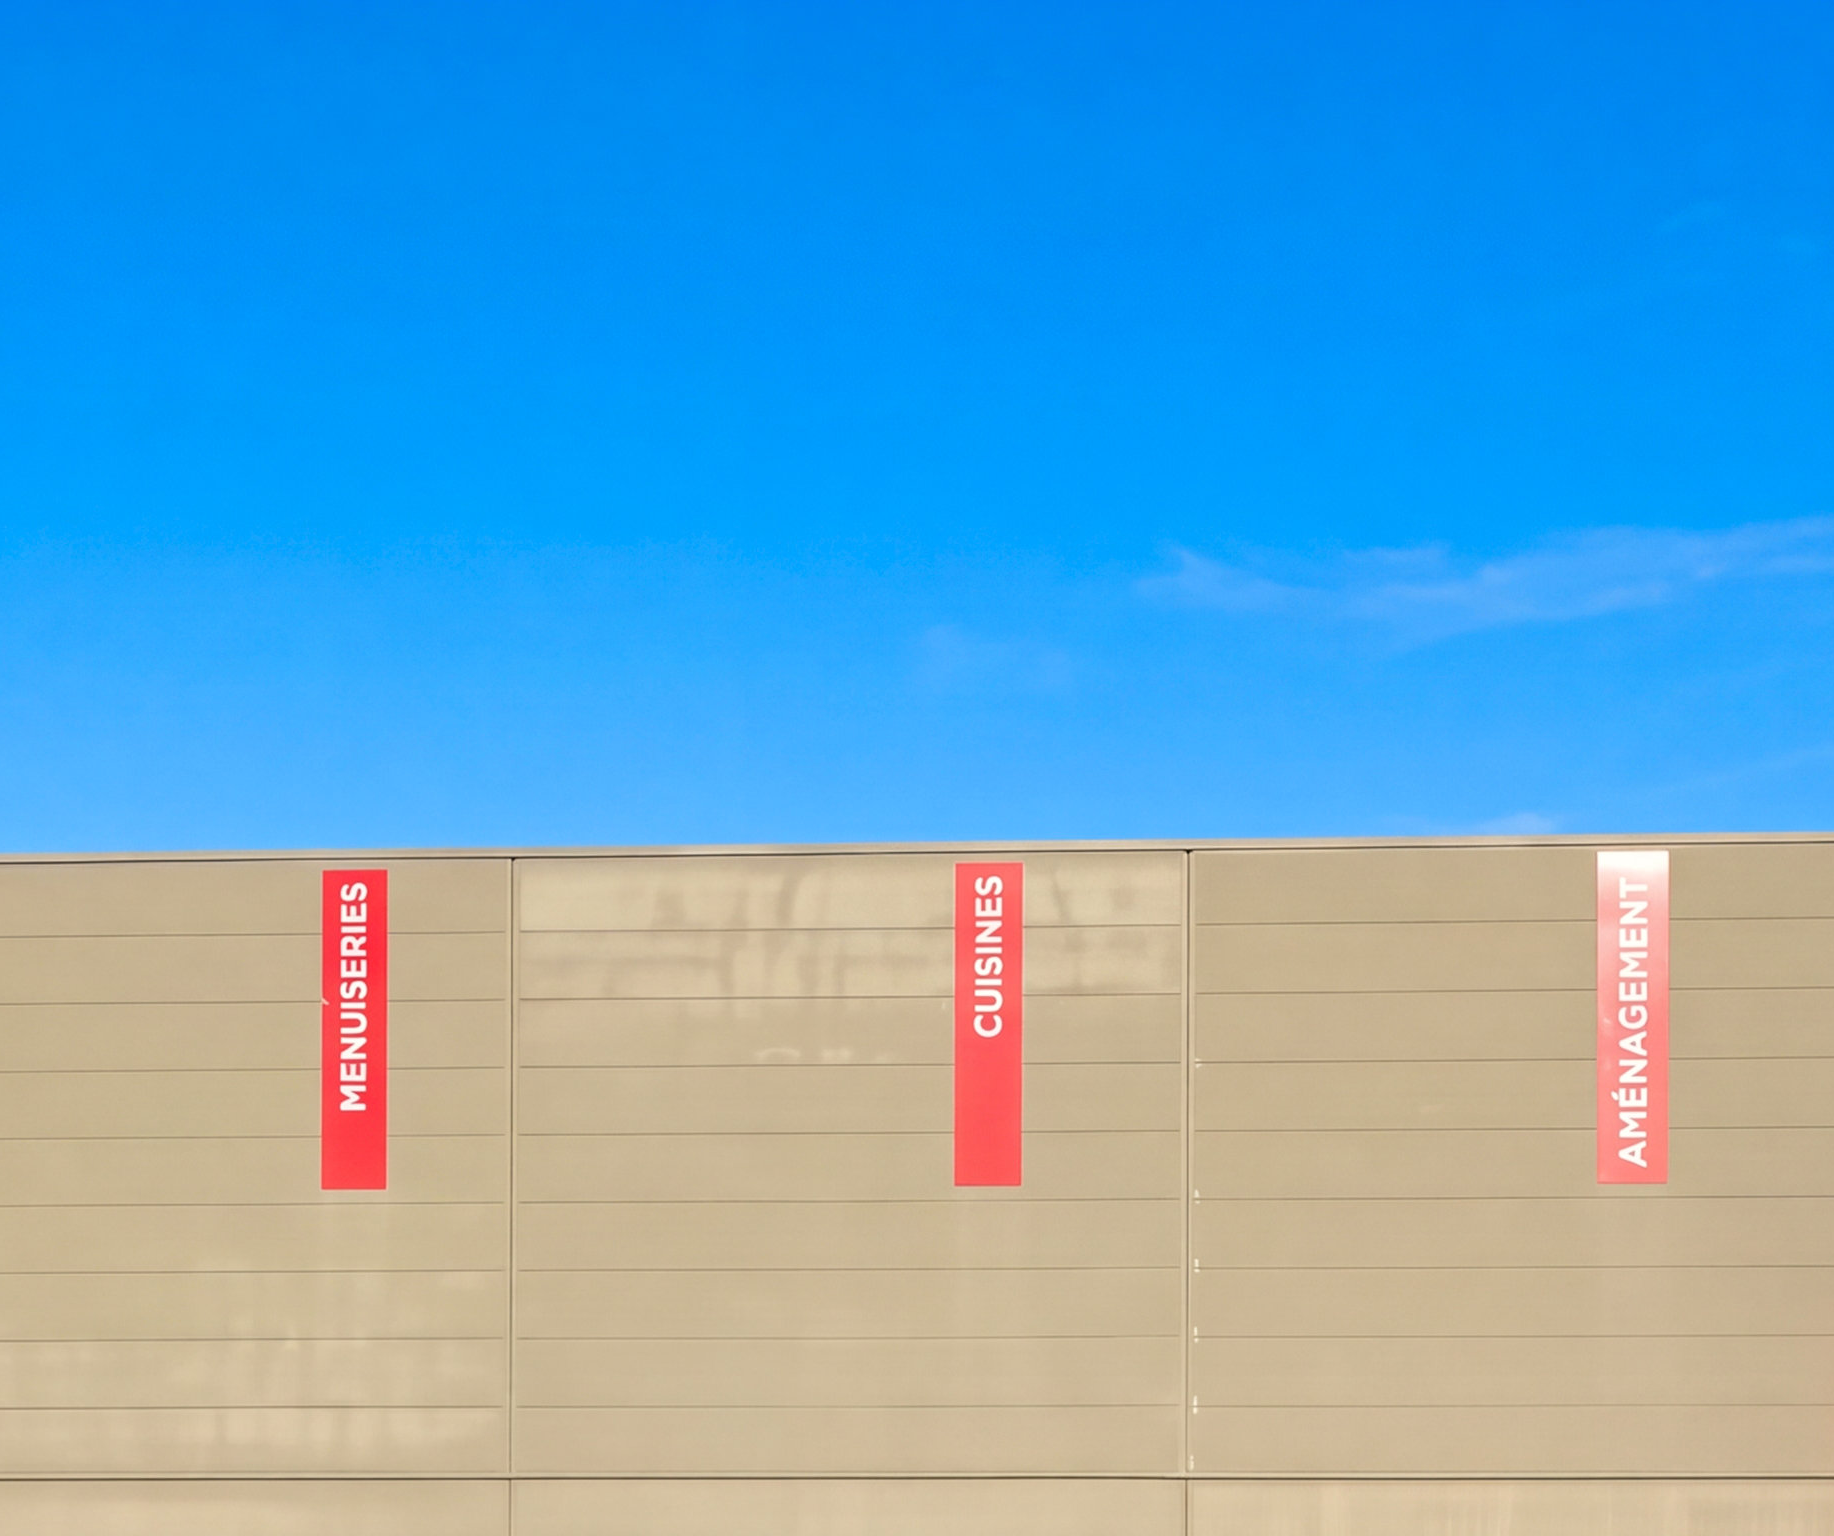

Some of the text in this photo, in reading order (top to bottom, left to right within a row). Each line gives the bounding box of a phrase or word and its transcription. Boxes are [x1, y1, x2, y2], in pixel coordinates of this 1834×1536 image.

[339, 882, 368, 1111] MENUISERIES
[973, 875, 1003, 1038] CUISINES
[1611, 876, 1648, 1168] AMÉNAGEMENT
